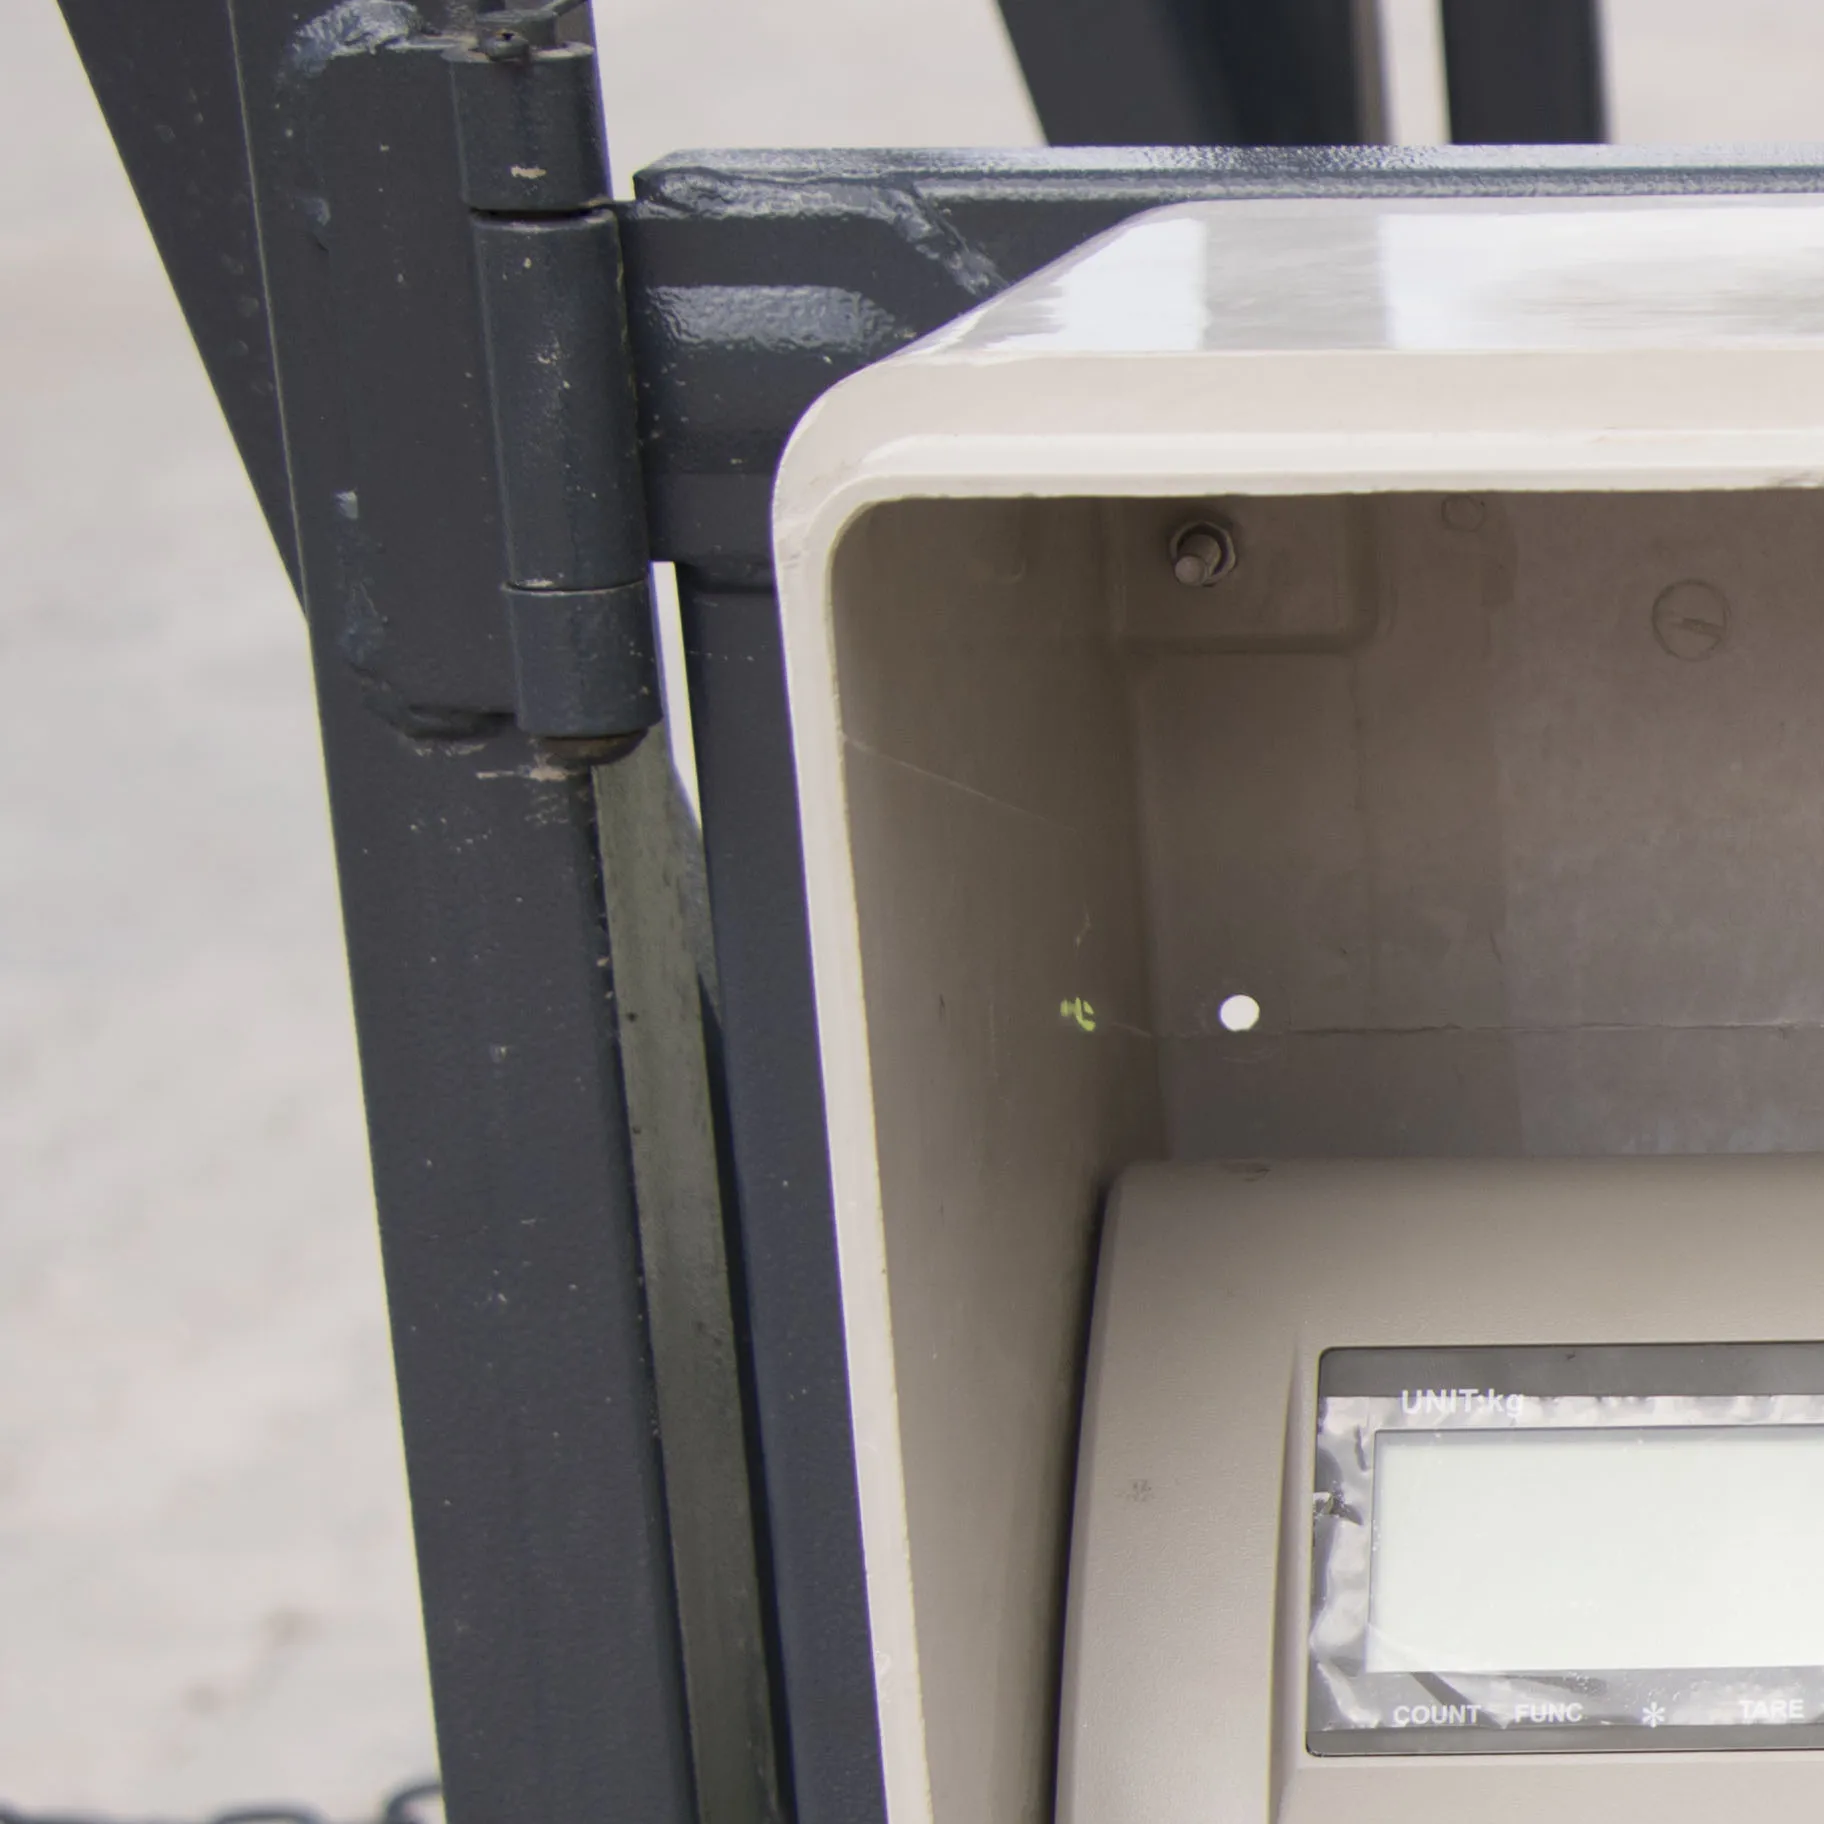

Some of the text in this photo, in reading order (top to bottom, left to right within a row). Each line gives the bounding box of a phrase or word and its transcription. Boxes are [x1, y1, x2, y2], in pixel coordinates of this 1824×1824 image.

[1393, 1704, 1481, 1725] COUNT
[1514, 1702, 1584, 1723] FUNC
[1741, 1700, 1805, 1720] TARE
